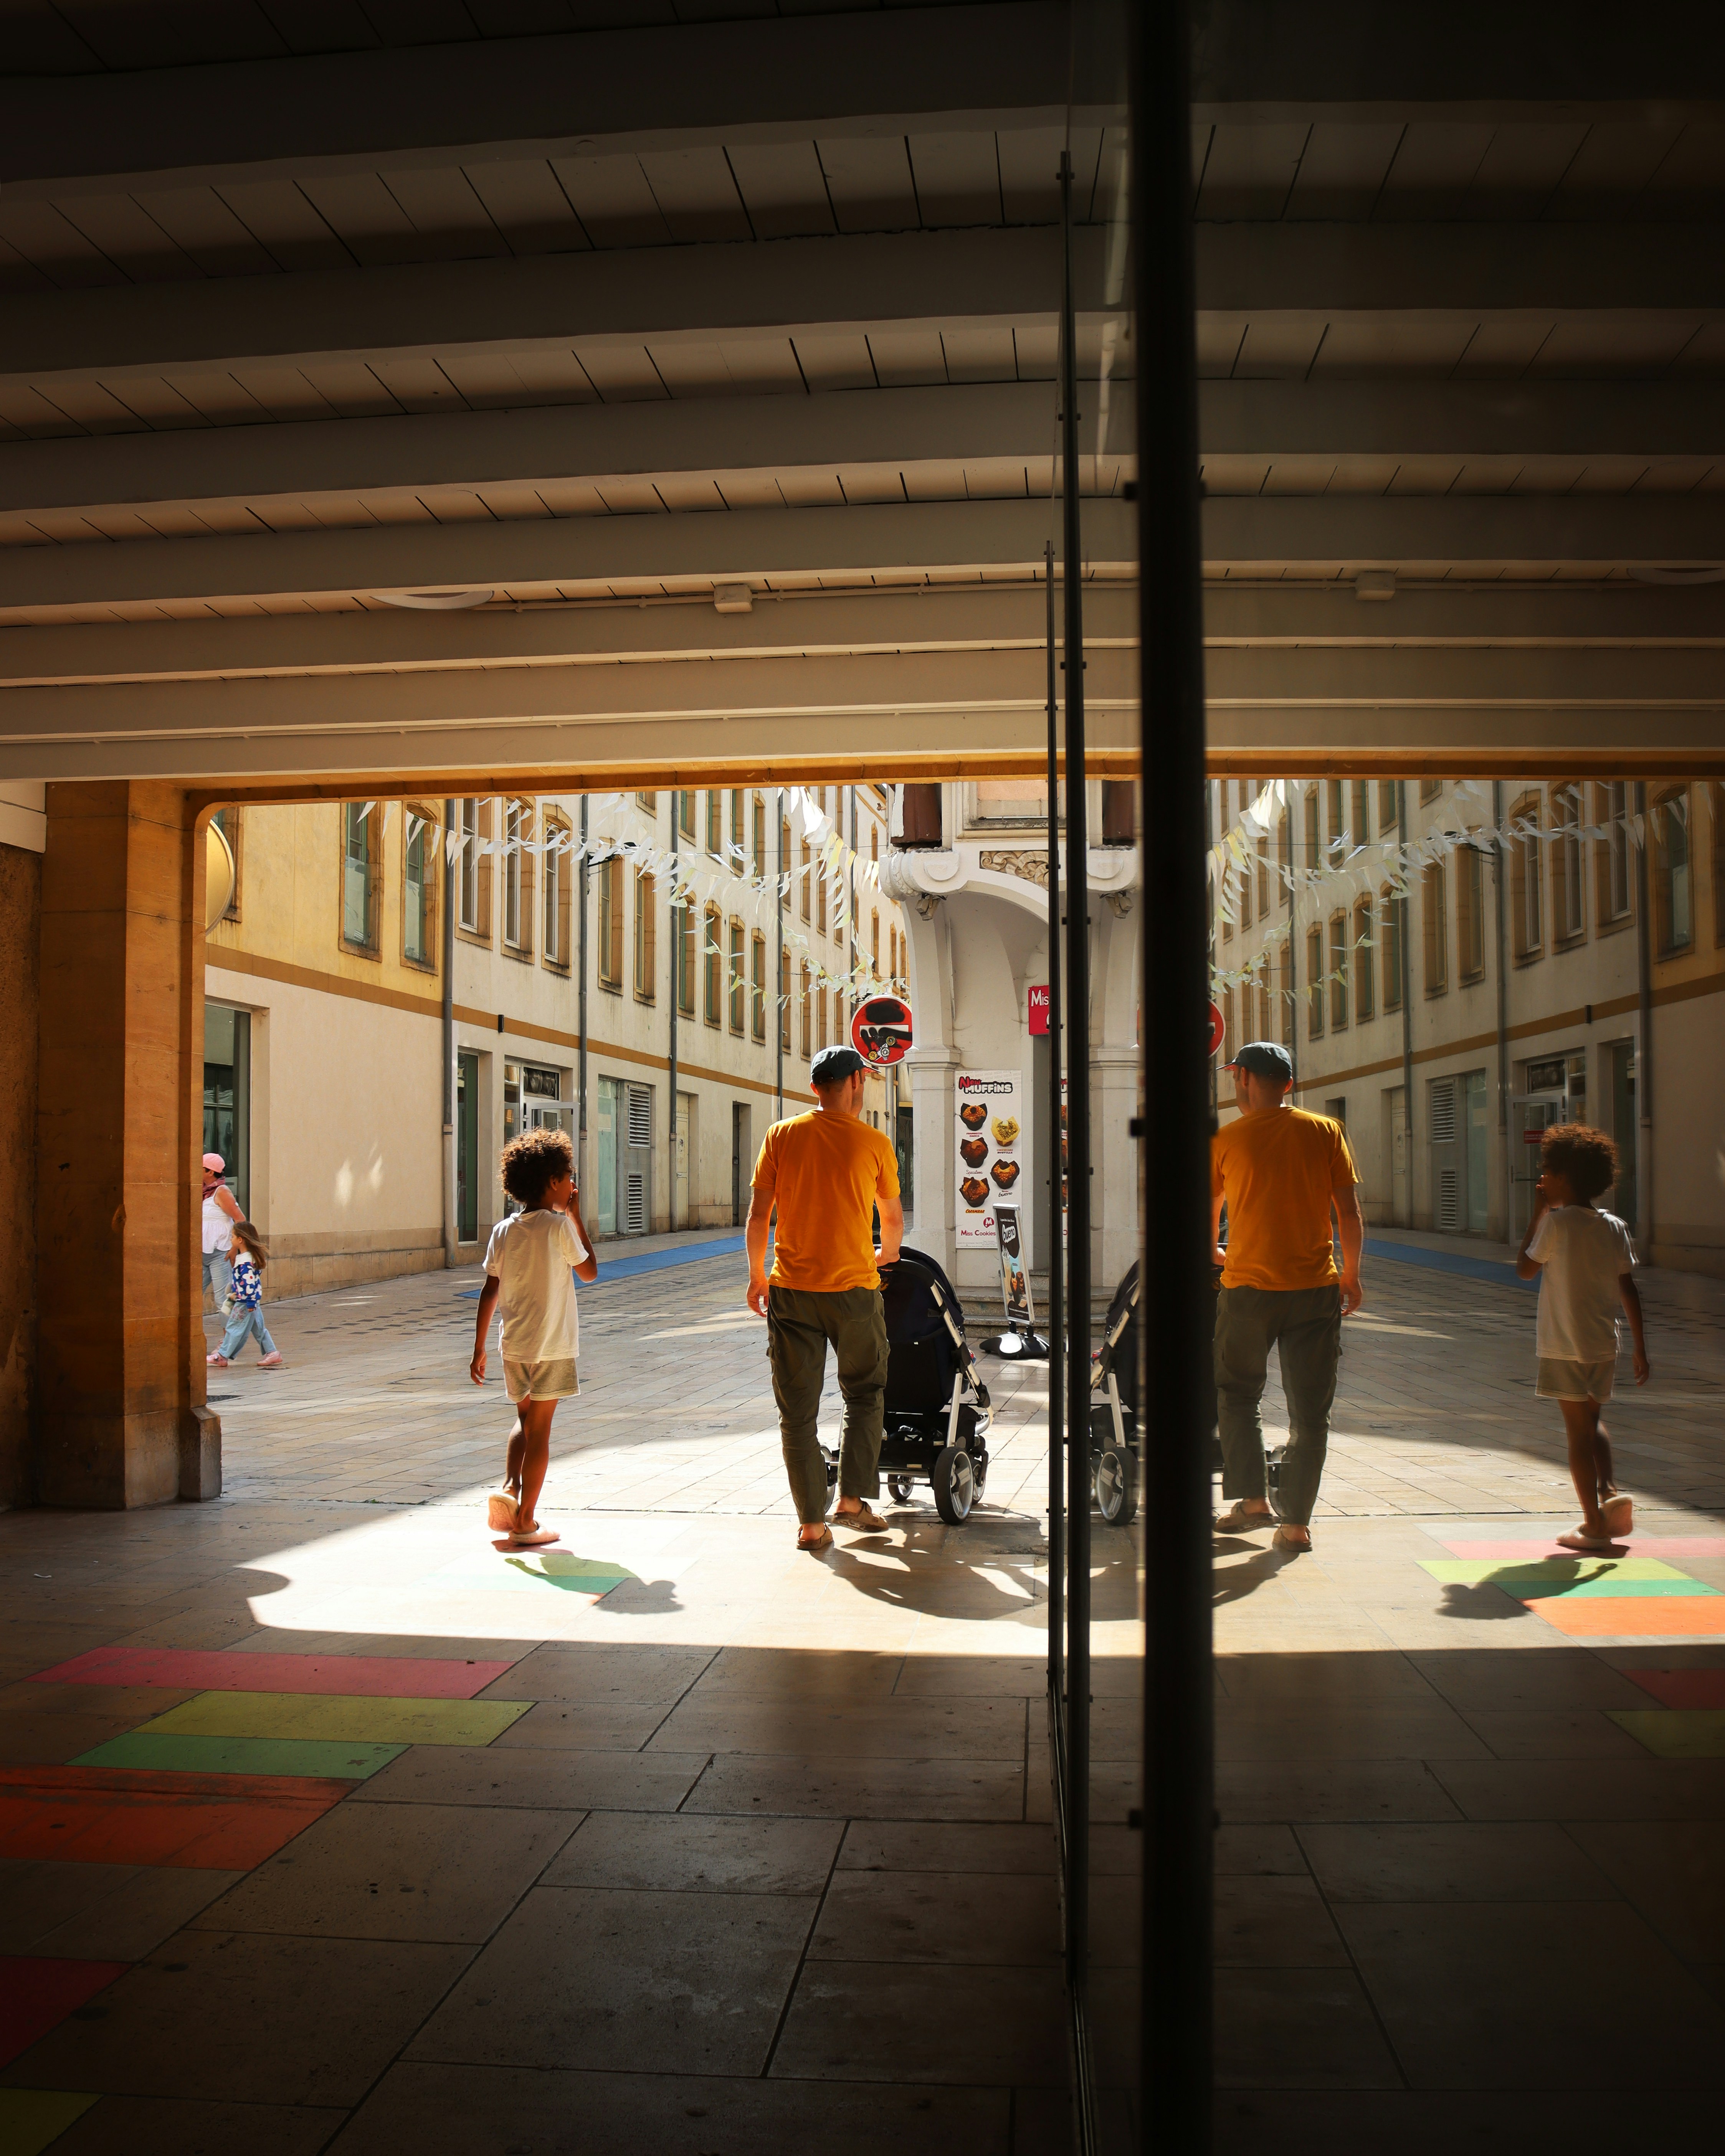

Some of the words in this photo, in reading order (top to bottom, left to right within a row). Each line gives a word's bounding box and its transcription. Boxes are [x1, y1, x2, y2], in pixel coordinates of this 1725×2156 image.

[1031, 989, 1049, 1007] Mis
[959, 1076, 981, 1089] New
[1002, 1224, 1016, 1242] bueno
